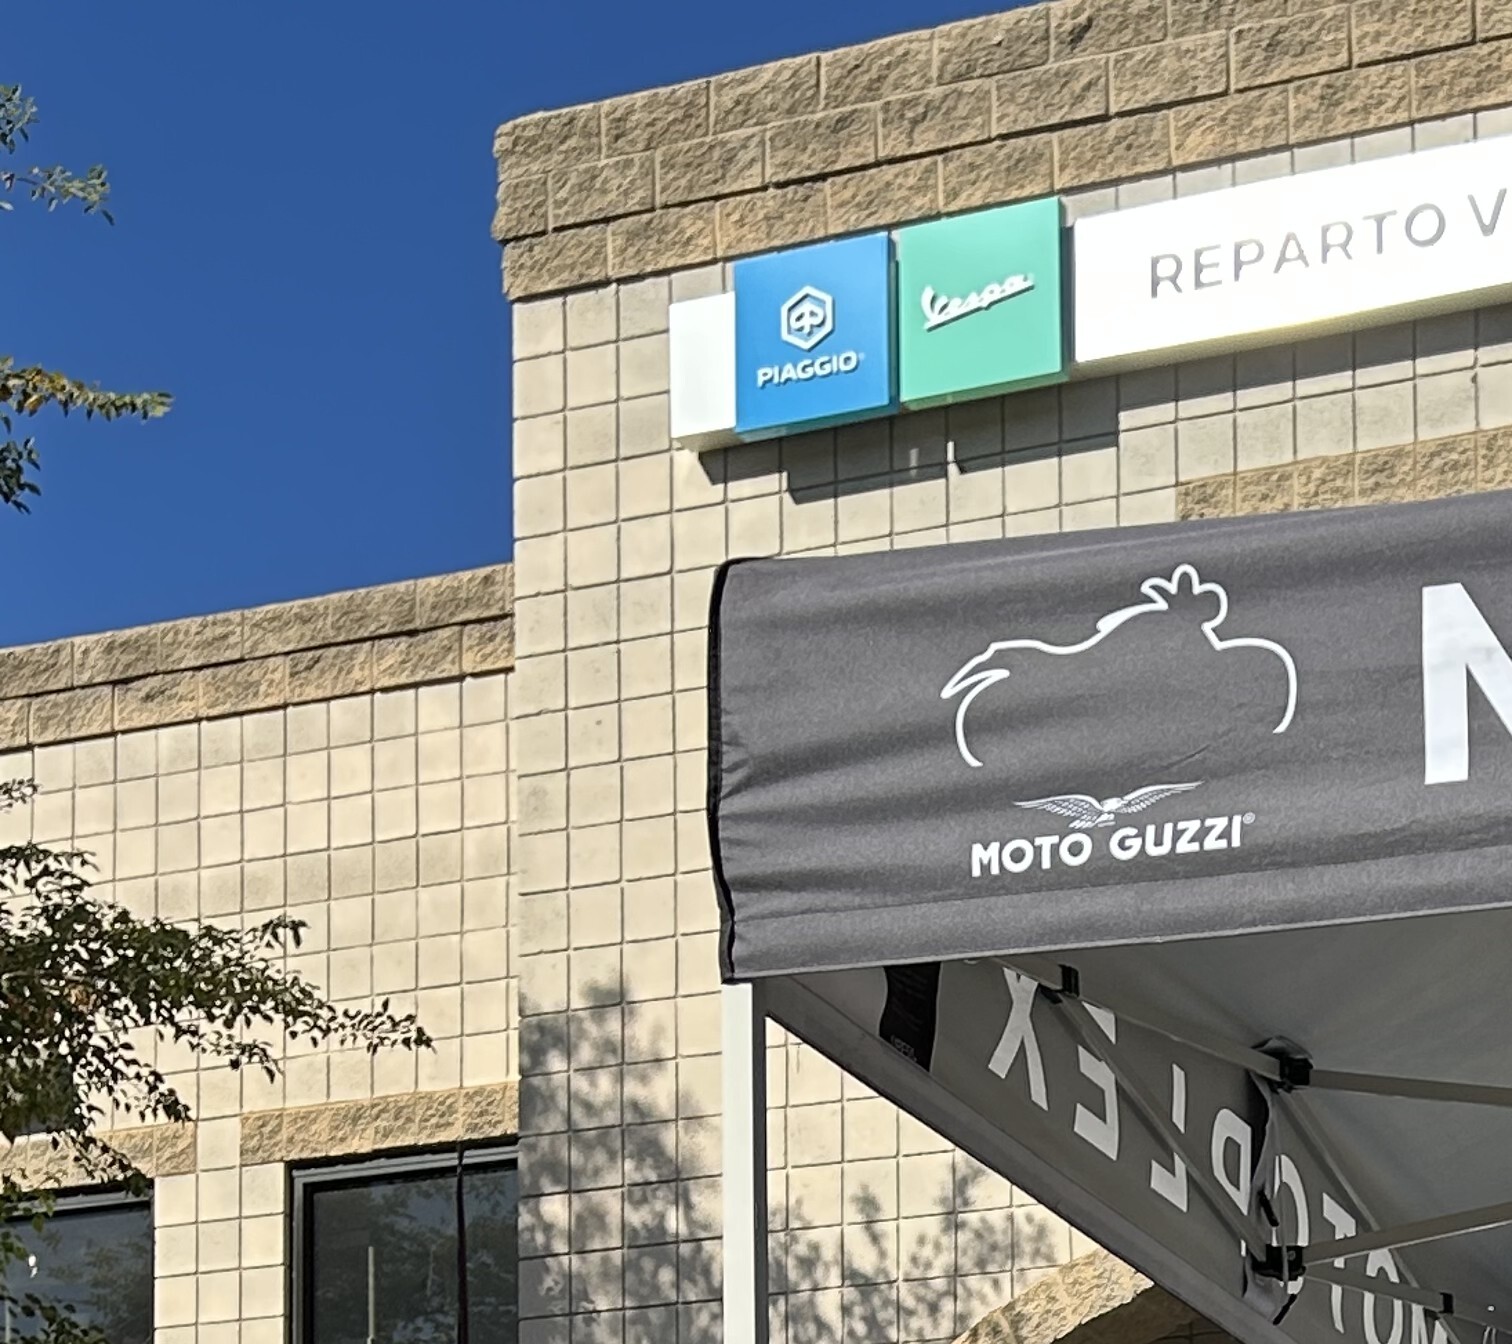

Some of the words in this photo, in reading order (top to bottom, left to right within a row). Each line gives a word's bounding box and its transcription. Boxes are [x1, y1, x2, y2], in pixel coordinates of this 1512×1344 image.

[1149, 203, 1447, 300] REPARTO
[920, 271, 1035, 331] Vespa
[756, 349, 860, 390] PIAGGIO
[970, 832, 1093, 878] MOTO
[1110, 814, 1244, 861] GUZZI
